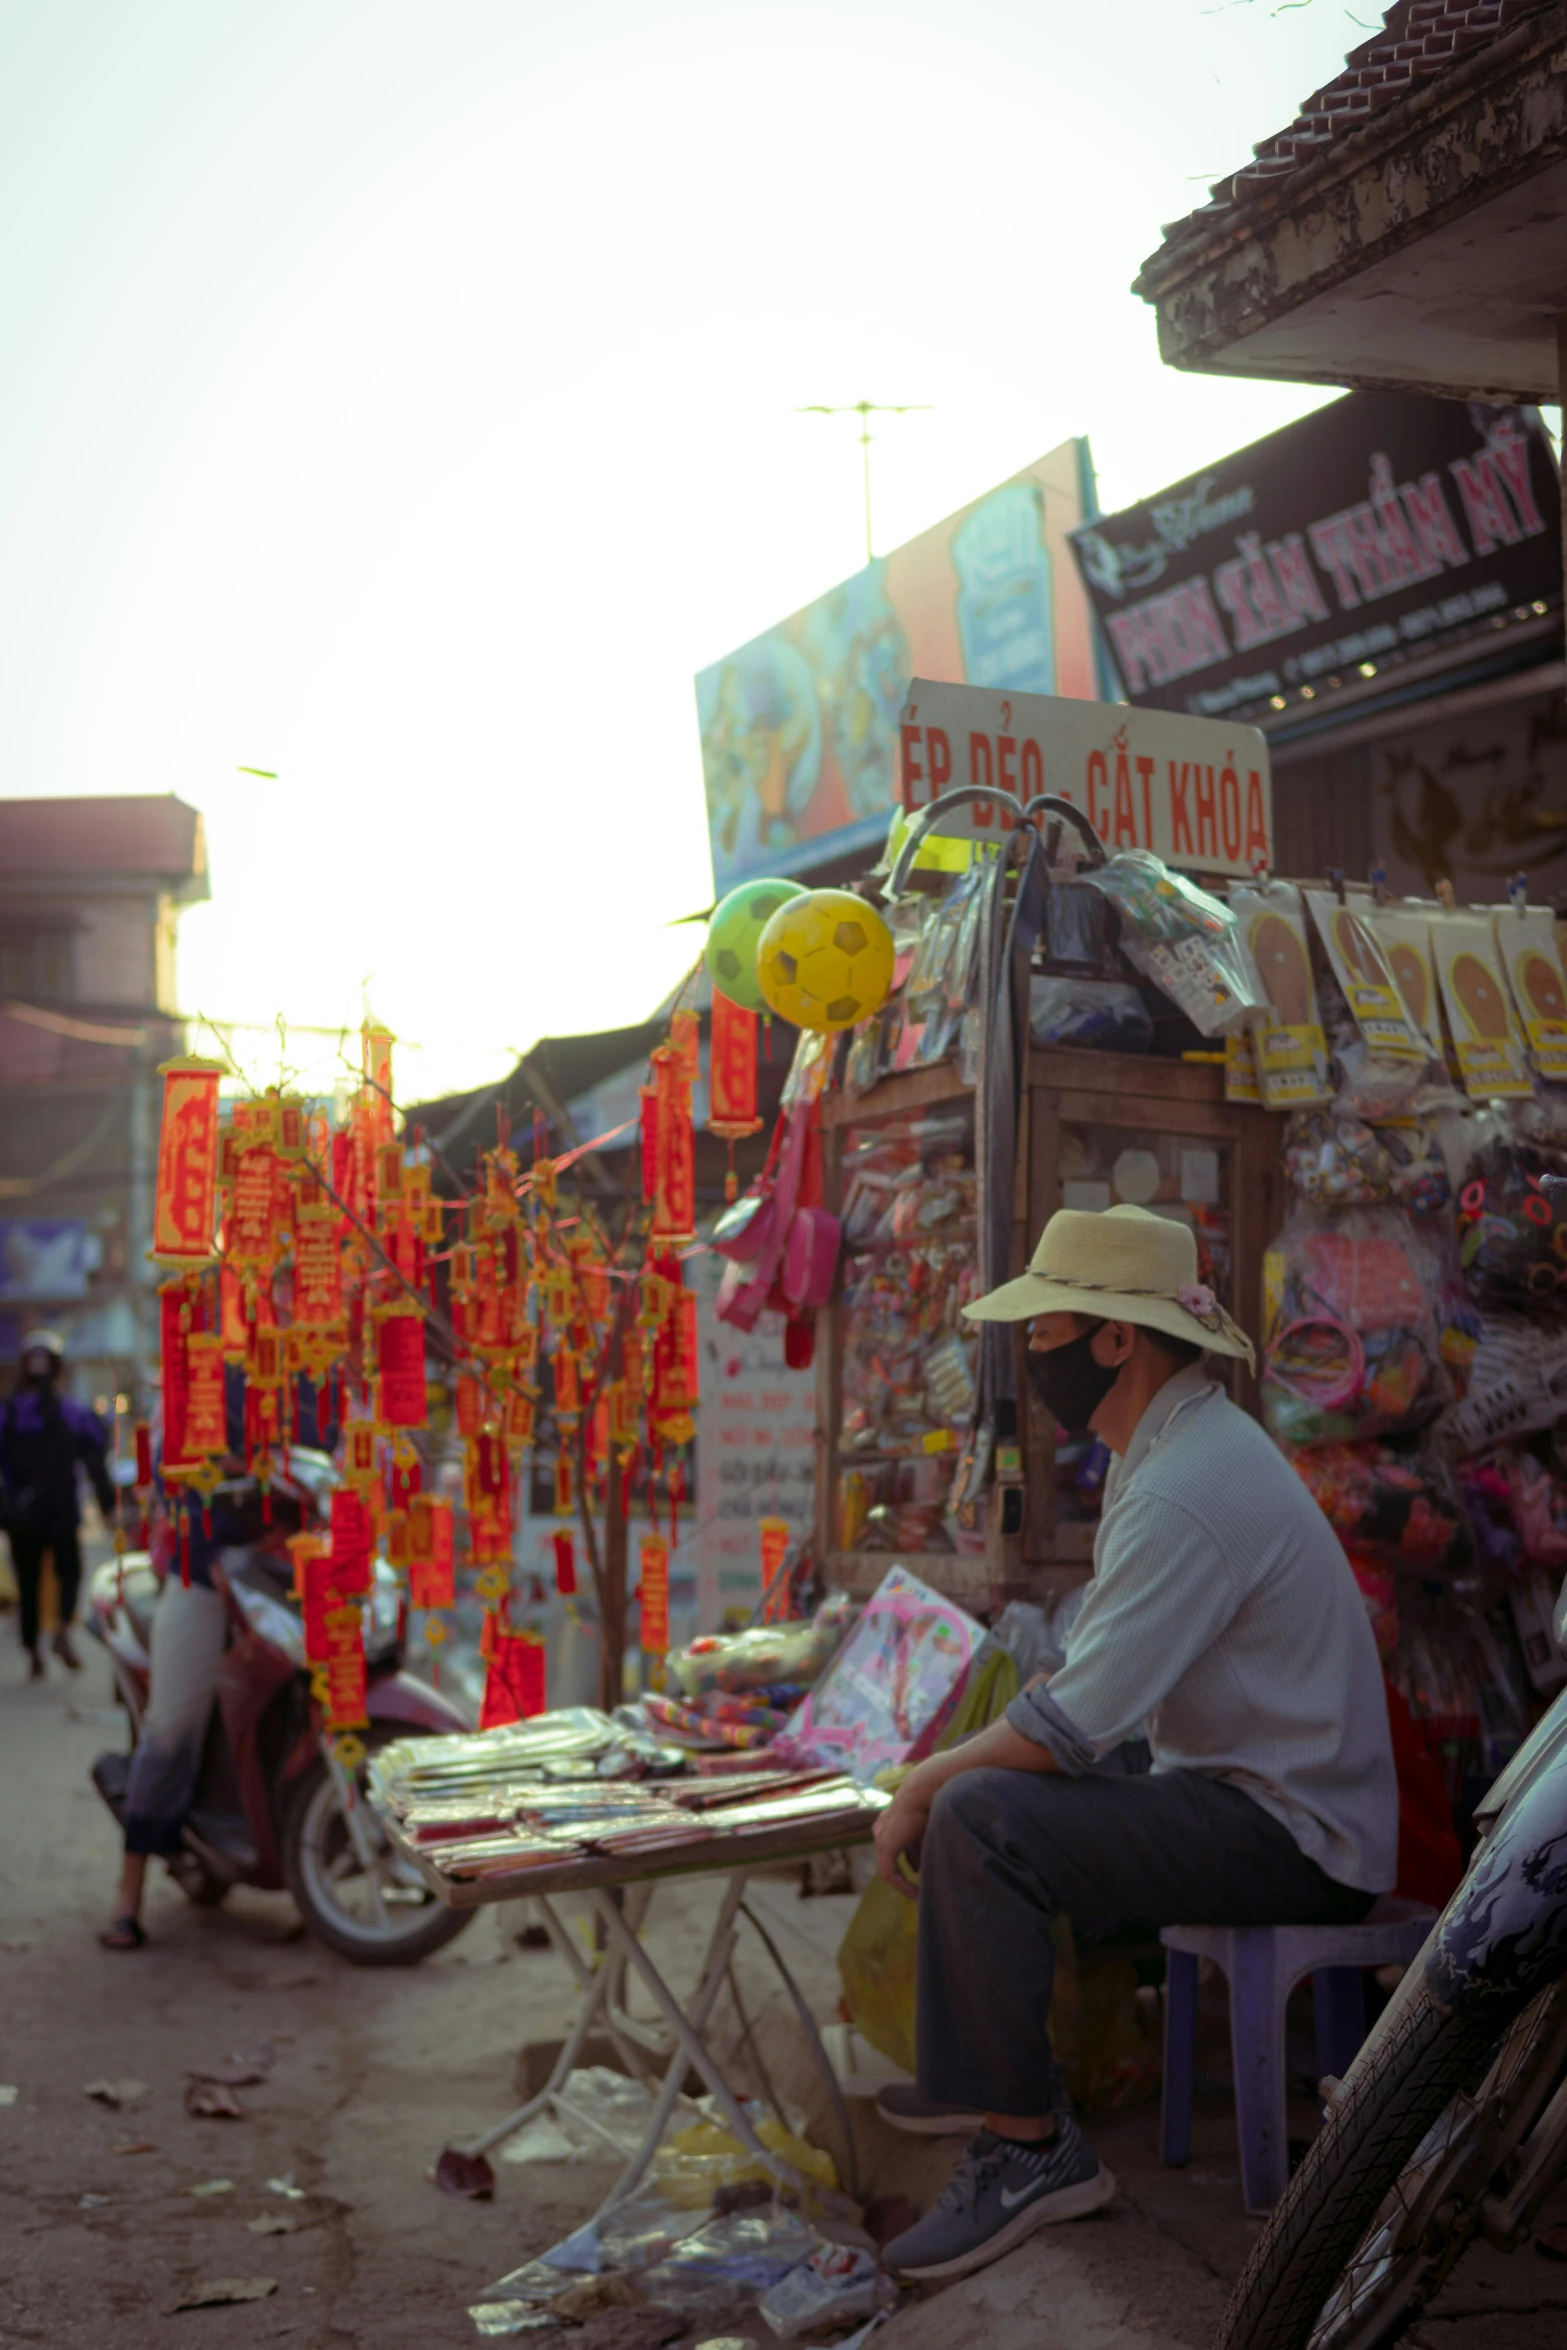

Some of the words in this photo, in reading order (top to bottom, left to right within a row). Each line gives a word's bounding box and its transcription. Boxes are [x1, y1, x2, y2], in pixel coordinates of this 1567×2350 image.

[901, 704, 953, 818] ÉP
[1086, 724, 1156, 851] CẮT
[1167, 748, 1270, 866] KHÓA
